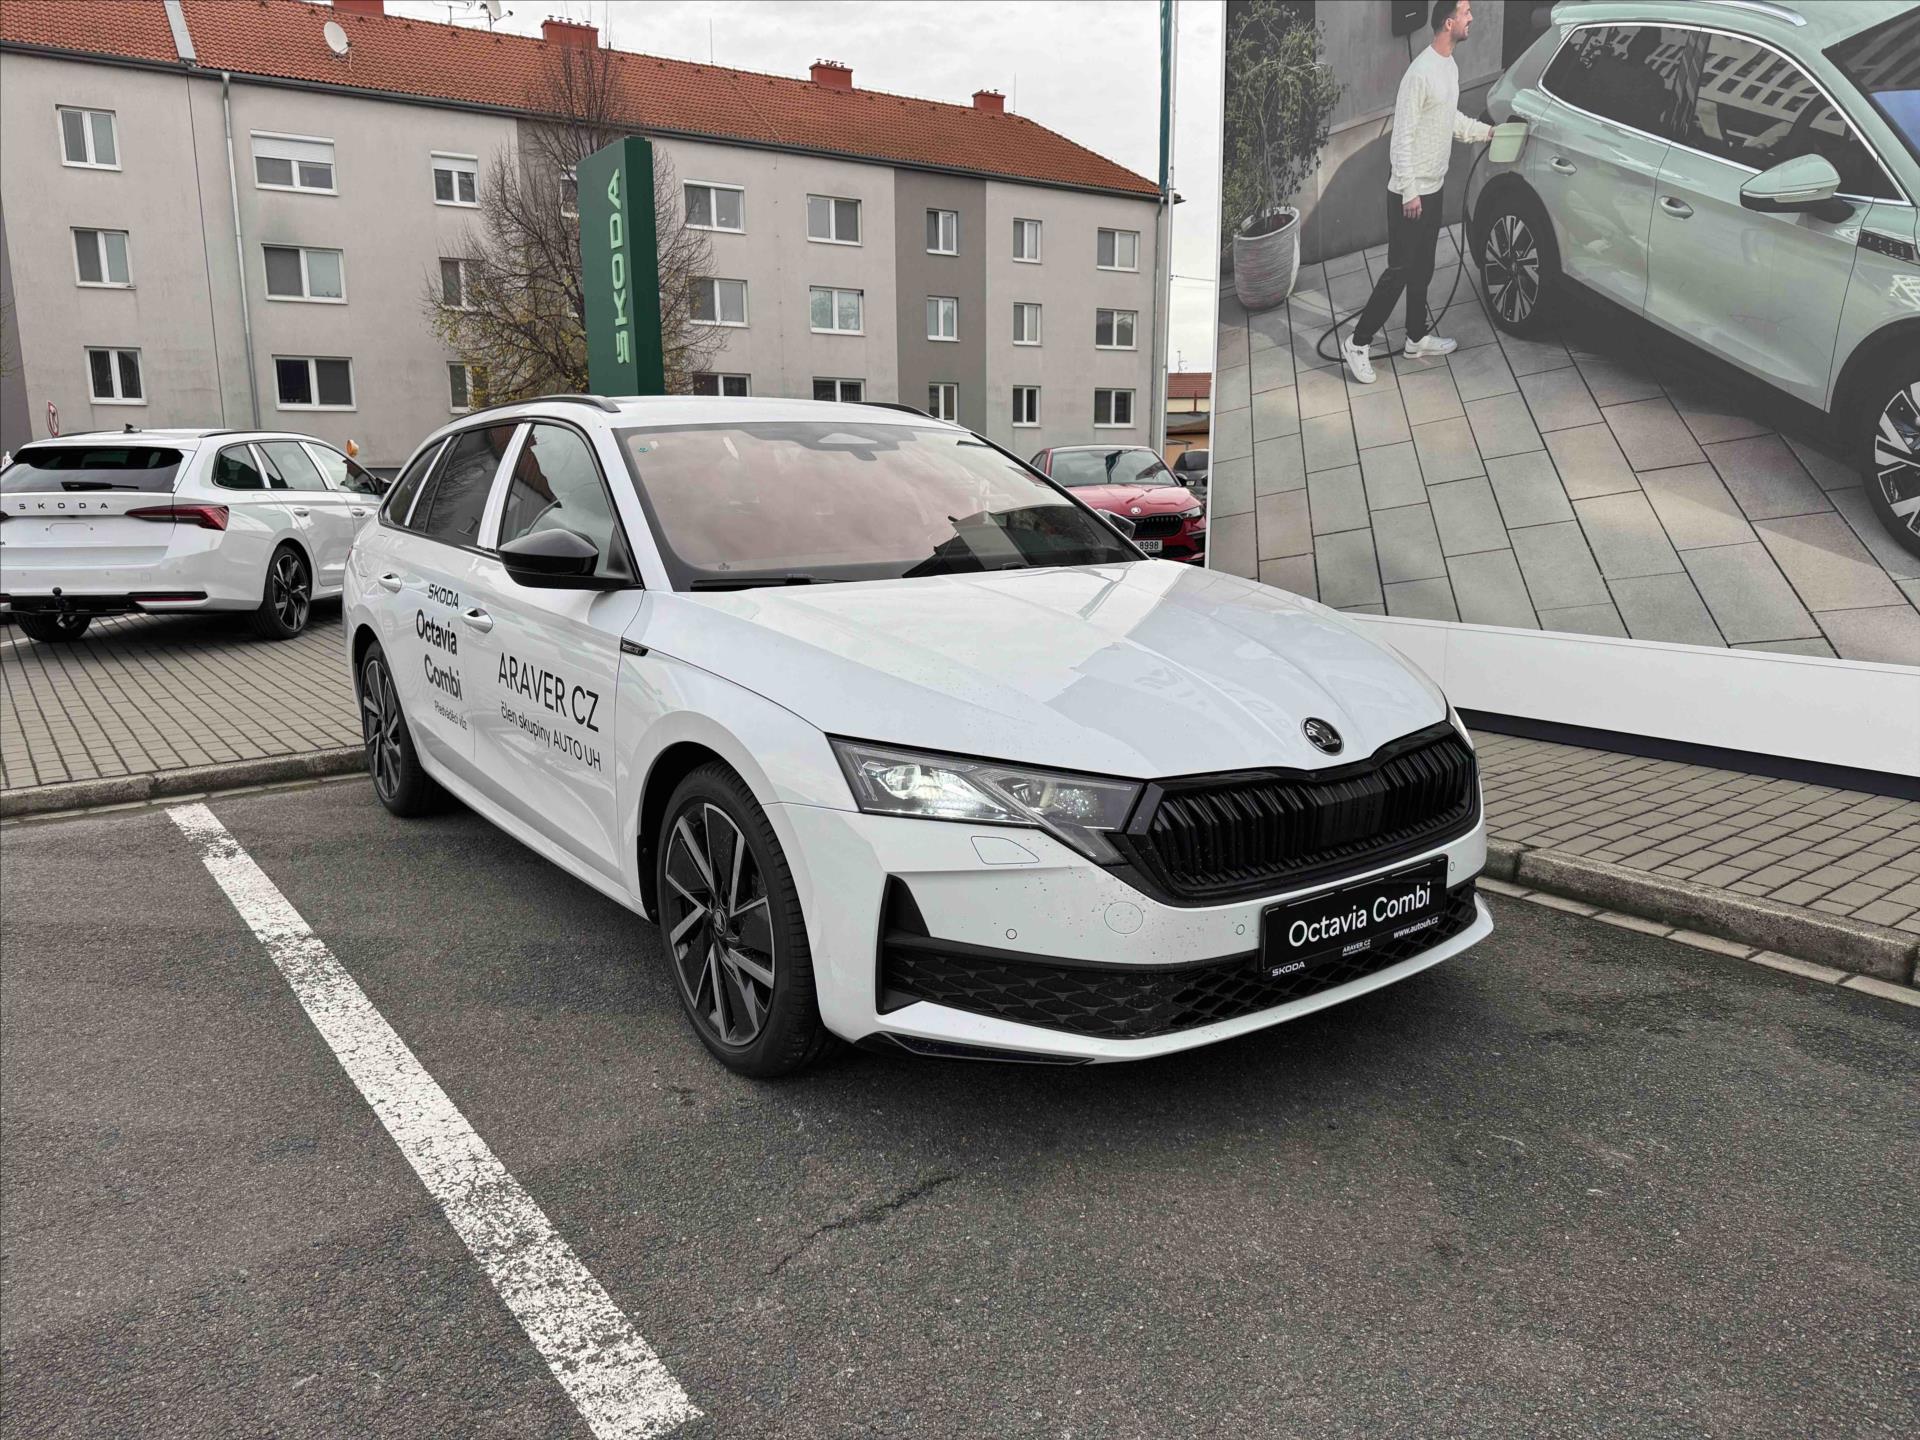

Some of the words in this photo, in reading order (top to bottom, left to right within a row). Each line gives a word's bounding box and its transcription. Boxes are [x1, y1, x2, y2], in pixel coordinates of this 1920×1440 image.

[416, 609, 458, 656] Octavia
[424, 653, 463, 701] Combi
[498, 652, 567, 718] ARAVER
[572, 685, 599, 733] CZ
[501, 700, 518, 726] člen
[518, 712, 551, 748] skupiny
[553, 729, 583, 760] AUTO
[584, 744, 602, 773] UH
[1288, 905, 1368, 947] Octavia
[1372, 882, 1431, 923] Combi
